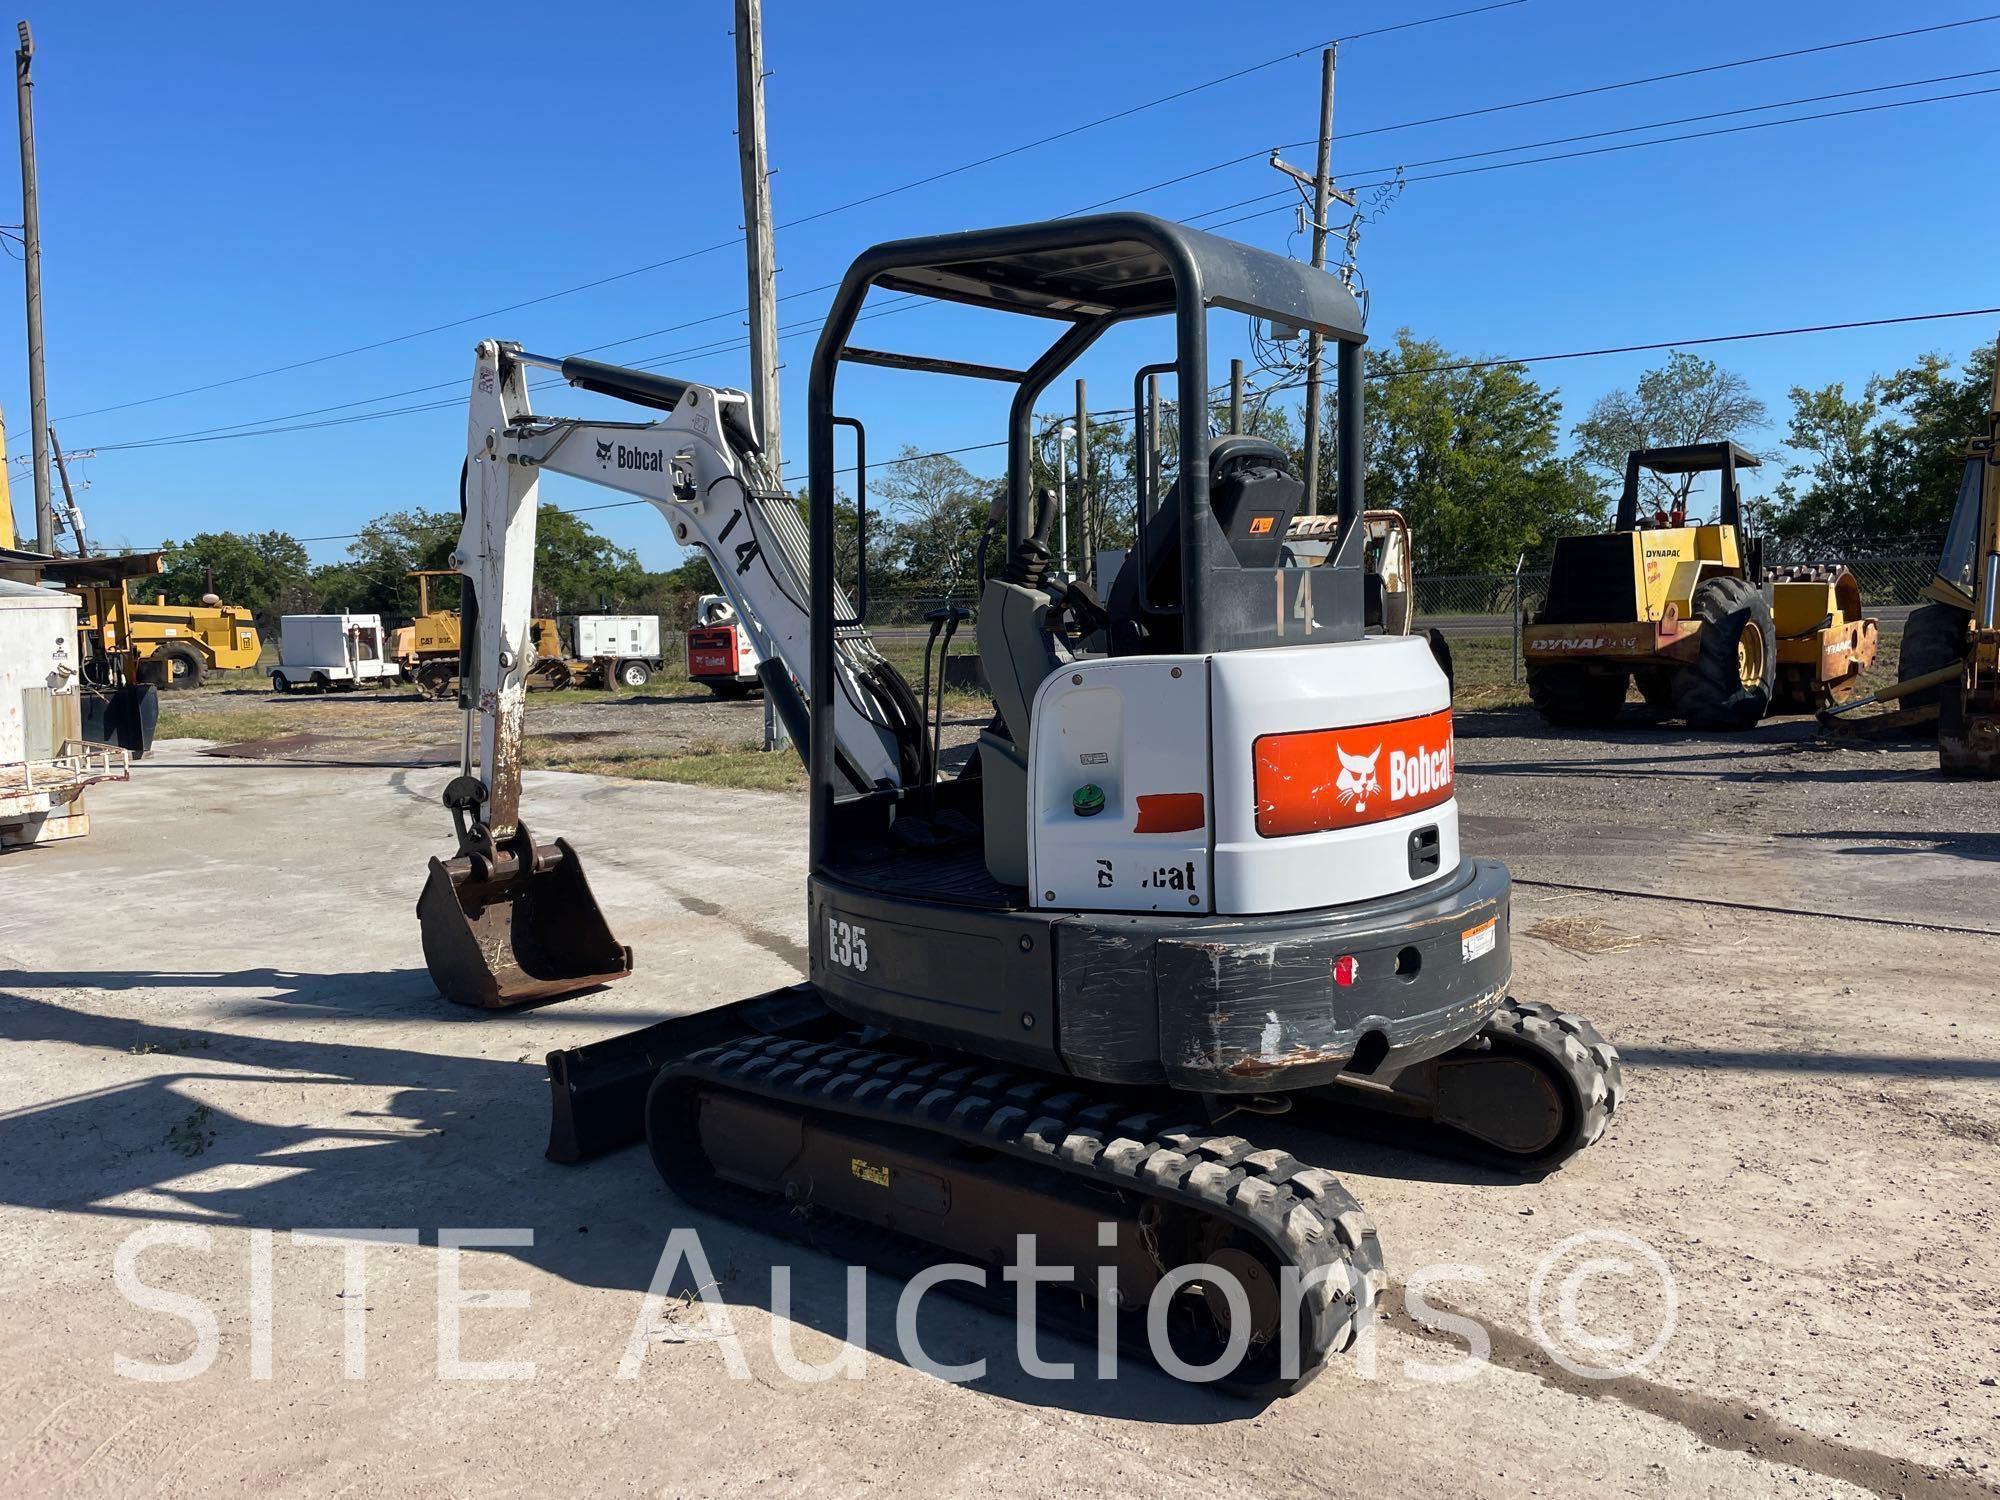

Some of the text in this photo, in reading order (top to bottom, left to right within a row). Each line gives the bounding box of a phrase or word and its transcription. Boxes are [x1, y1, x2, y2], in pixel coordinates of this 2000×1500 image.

[617, 445, 663, 472] Bobcat
[717, 508, 761, 577] 14
[1274, 569, 1315, 637] 14
[420, 637, 433, 645] CAT
[1389, 738, 1452, 802] Bobcat
[1096, 859, 1196, 891] Bcat
[828, 917, 868, 973] E35
